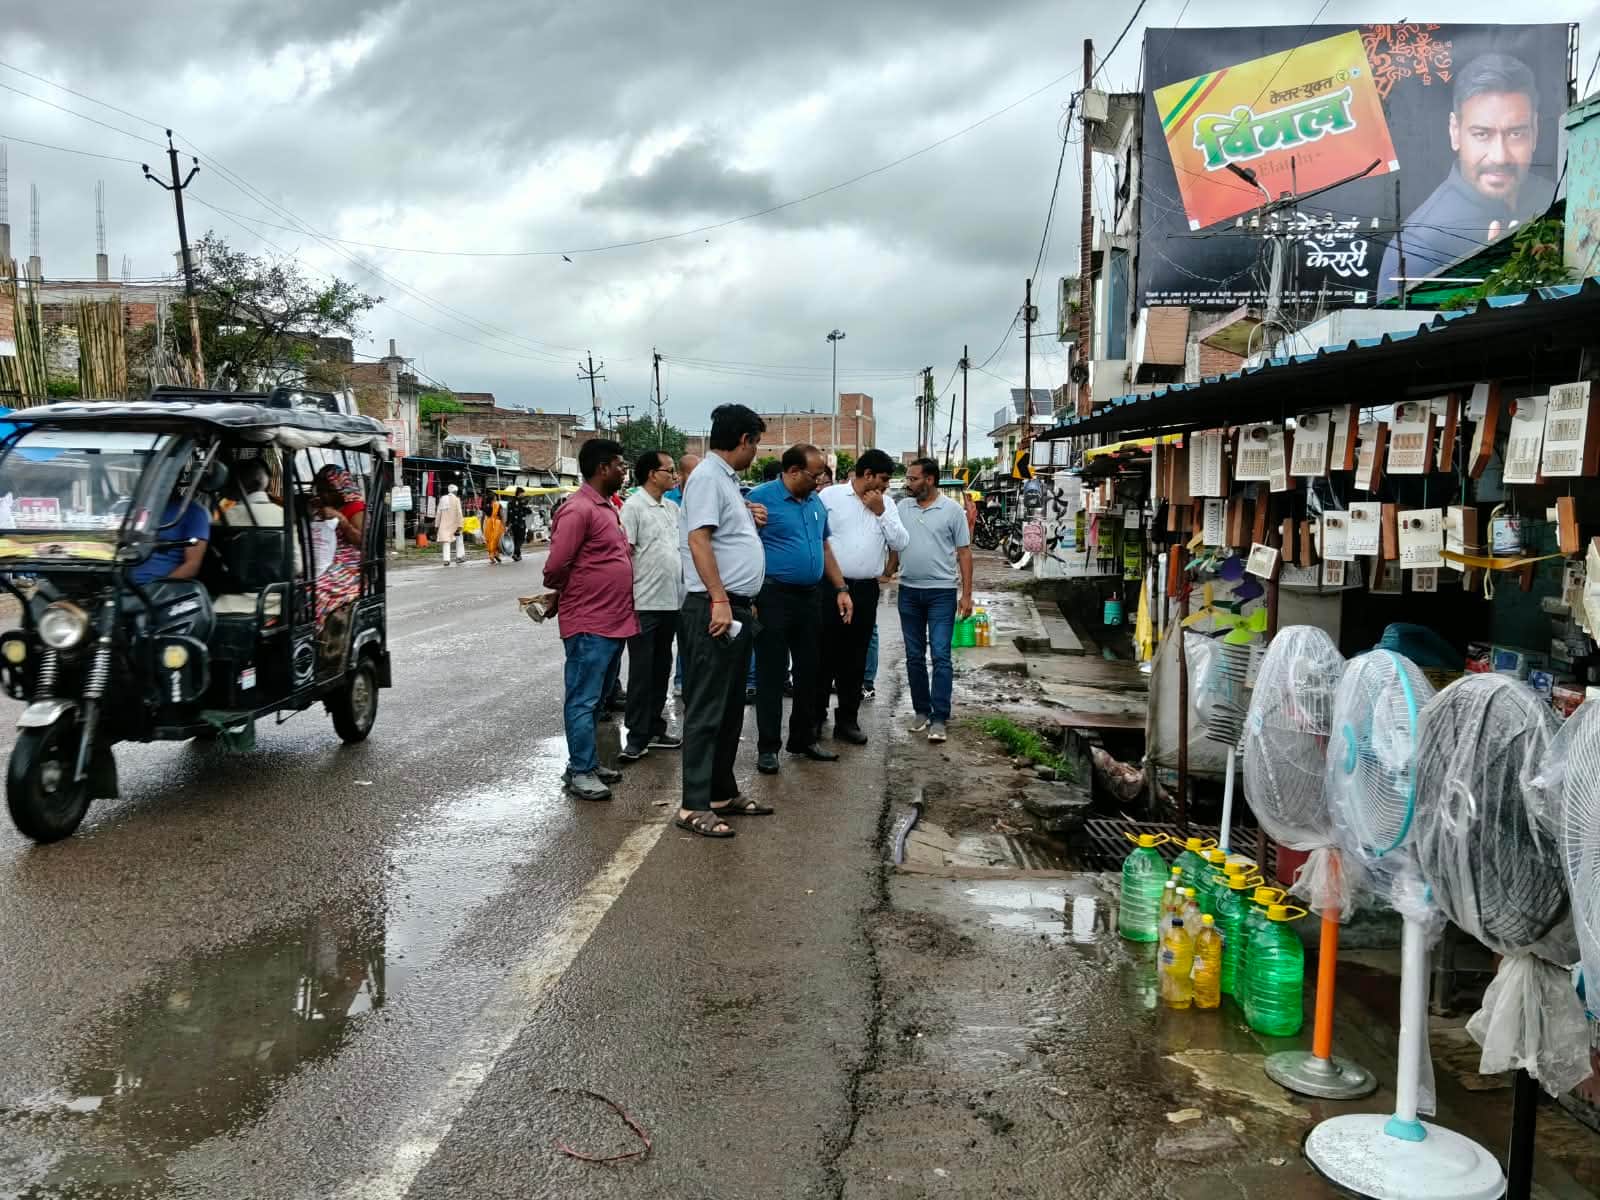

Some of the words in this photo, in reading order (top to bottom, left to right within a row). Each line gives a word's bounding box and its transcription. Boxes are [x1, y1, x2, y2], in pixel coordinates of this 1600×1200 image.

[1270, 76, 1334, 104] केसर-युक्त
[1194, 87, 1356, 171] विमल
[1304, 240, 1369, 277] केसरी
